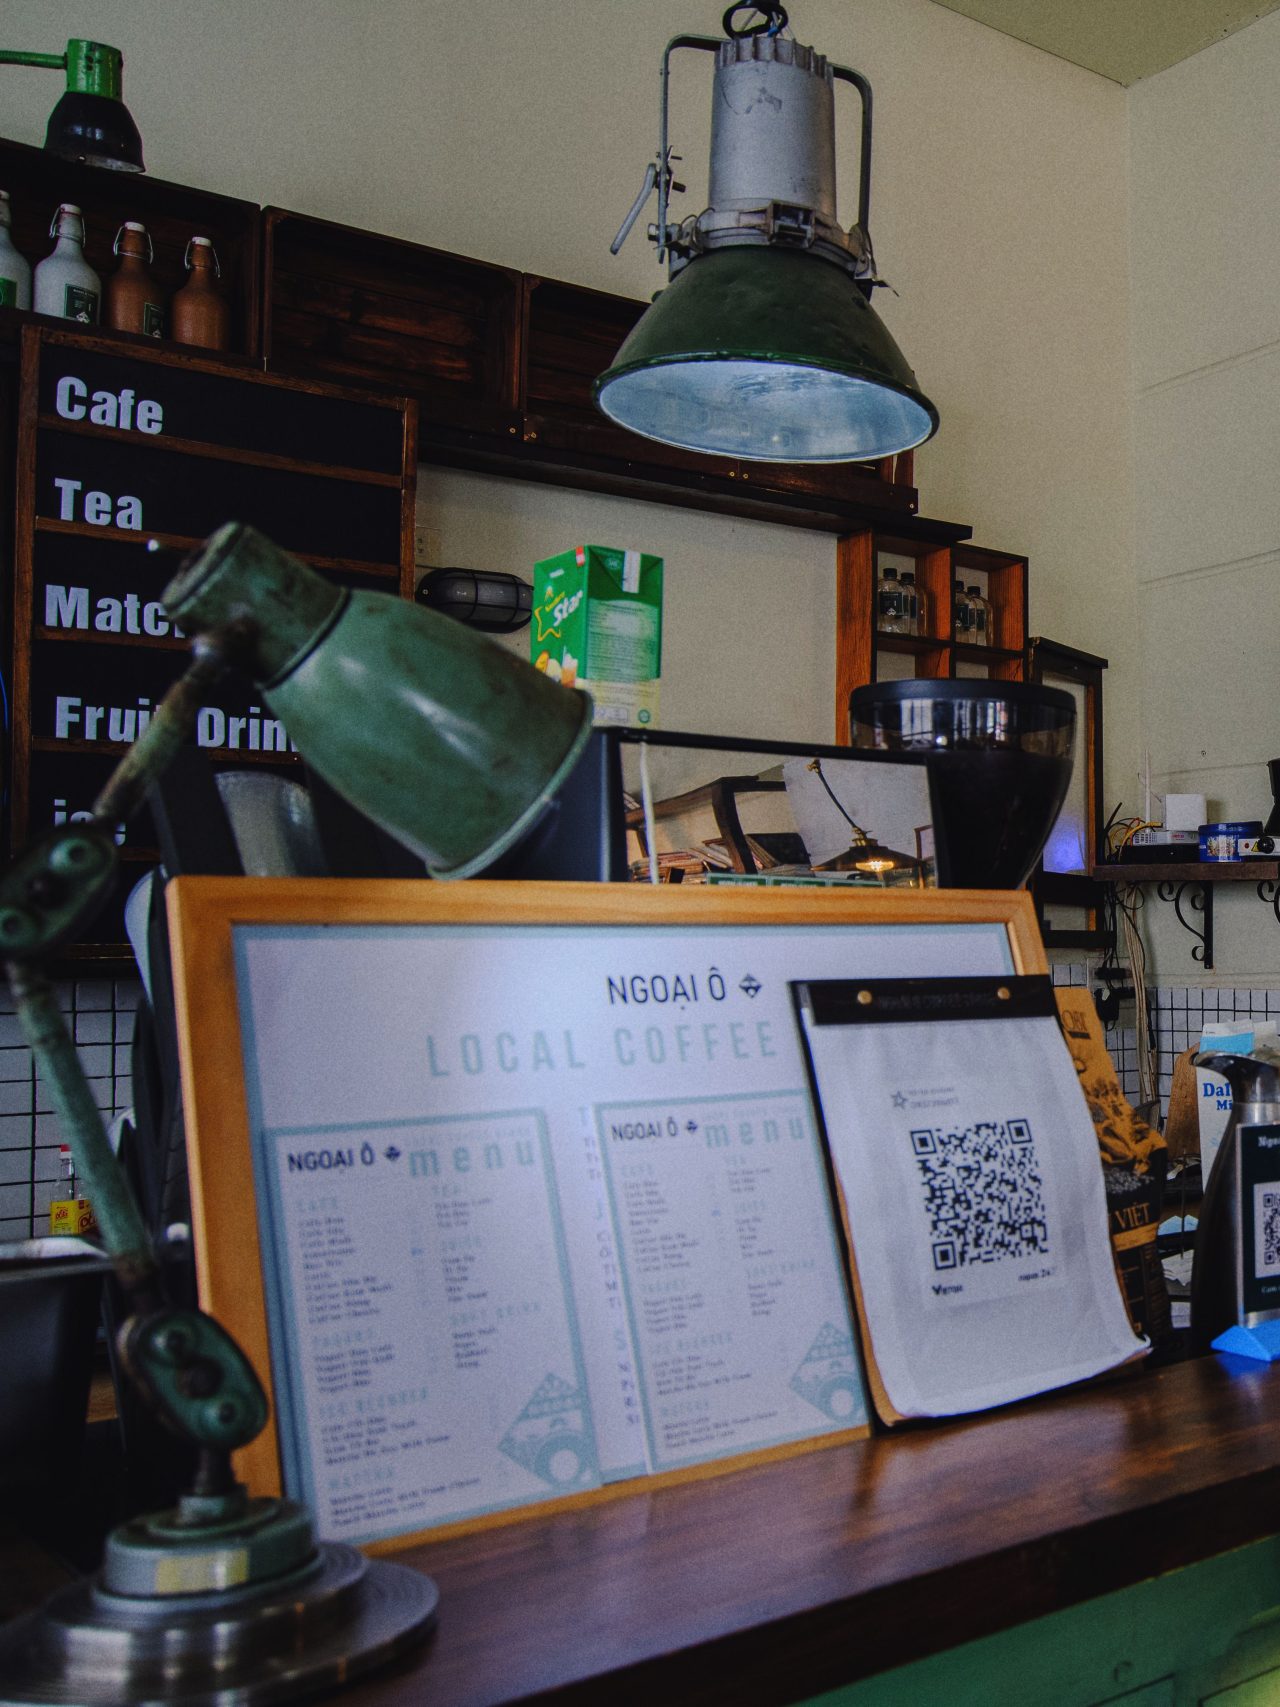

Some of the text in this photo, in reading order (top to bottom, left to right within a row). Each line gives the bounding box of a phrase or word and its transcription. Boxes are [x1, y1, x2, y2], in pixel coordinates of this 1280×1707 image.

[56, 376, 164, 435] Cafe
[54, 477, 143, 531] Tea
[44, 583, 186, 639] Matc
[55, 696, 299, 752] Frui Drin
[606, 966, 727, 1011] NGOẠI Ô
[426, 1020, 778, 1078] LOCAL COFFEE
[1202, 1082, 1231, 1097] Dal
[1216, 1099, 1233, 1110] Mi
[704, 1115, 805, 1149] menu
[408, 1140, 536, 1178] menu
